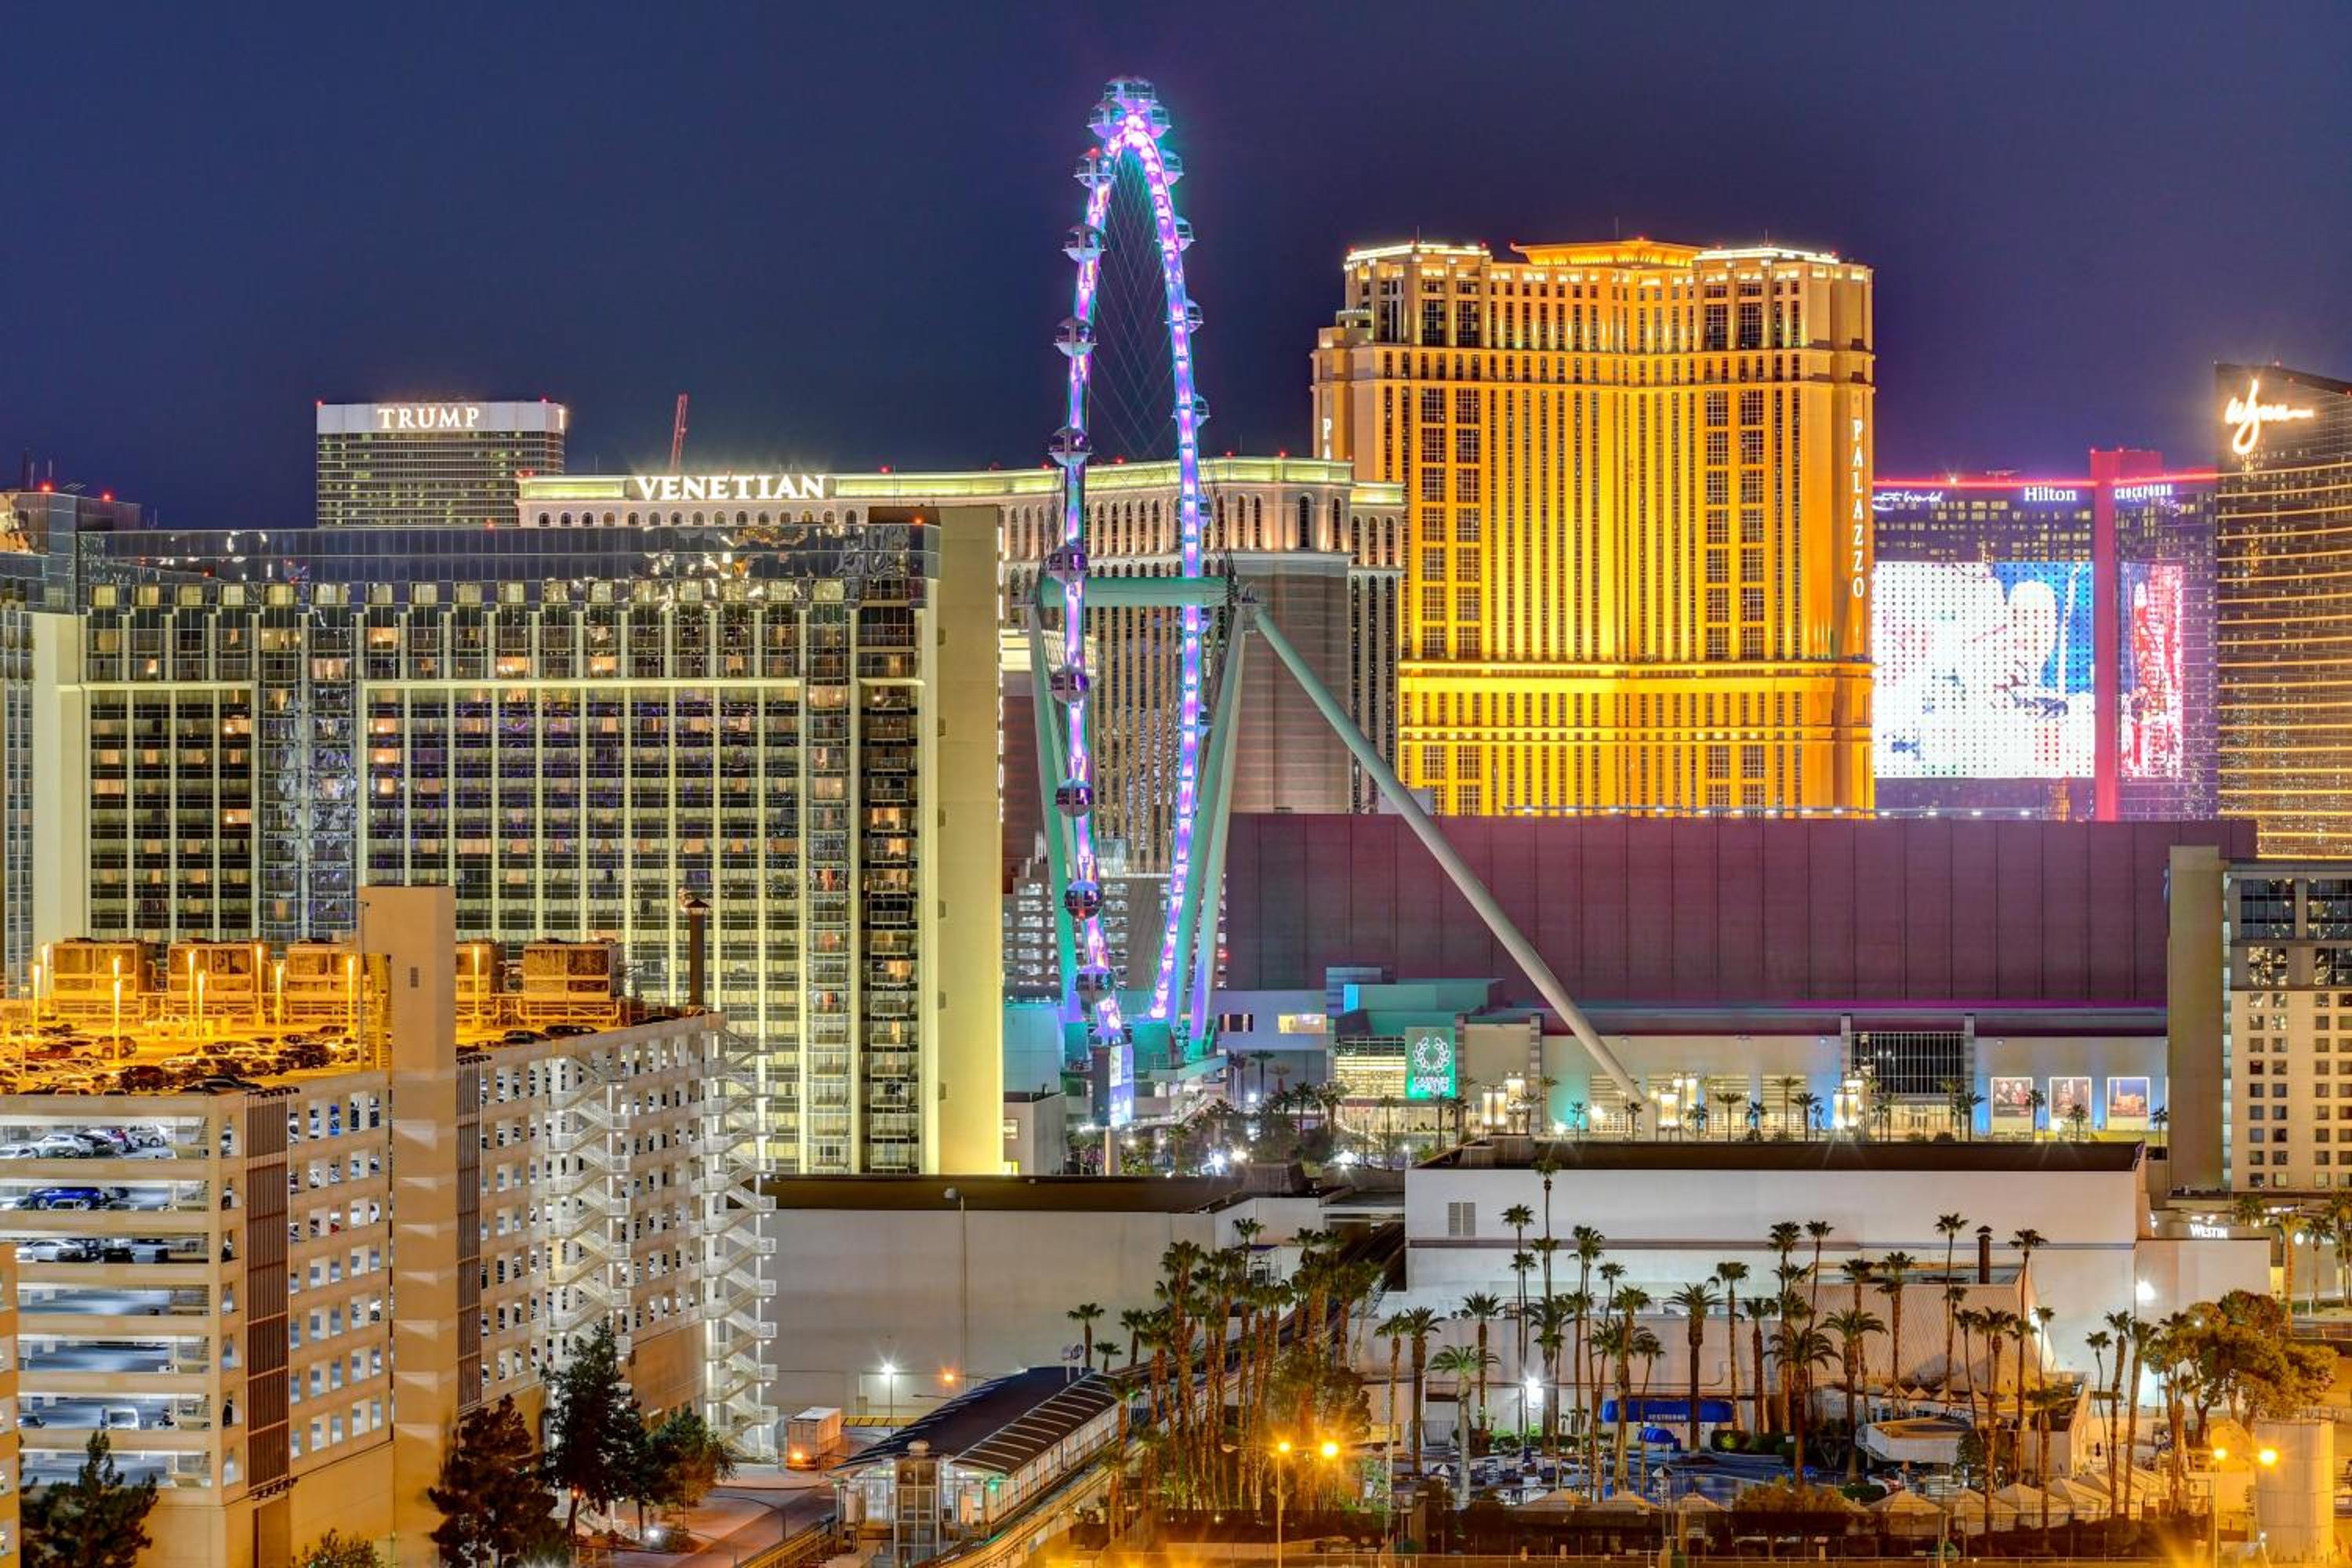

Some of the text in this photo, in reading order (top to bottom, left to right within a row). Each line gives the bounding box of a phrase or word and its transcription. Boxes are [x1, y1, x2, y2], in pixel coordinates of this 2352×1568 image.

[377, 408, 479, 429] TRUMP
[634, 474, 826, 500] VENETIAN
[2024, 487, 2077, 502] Hilton
[1853, 419, 1864, 598] PALAZZO
[2190, 1224, 2228, 1239] WESTIN
